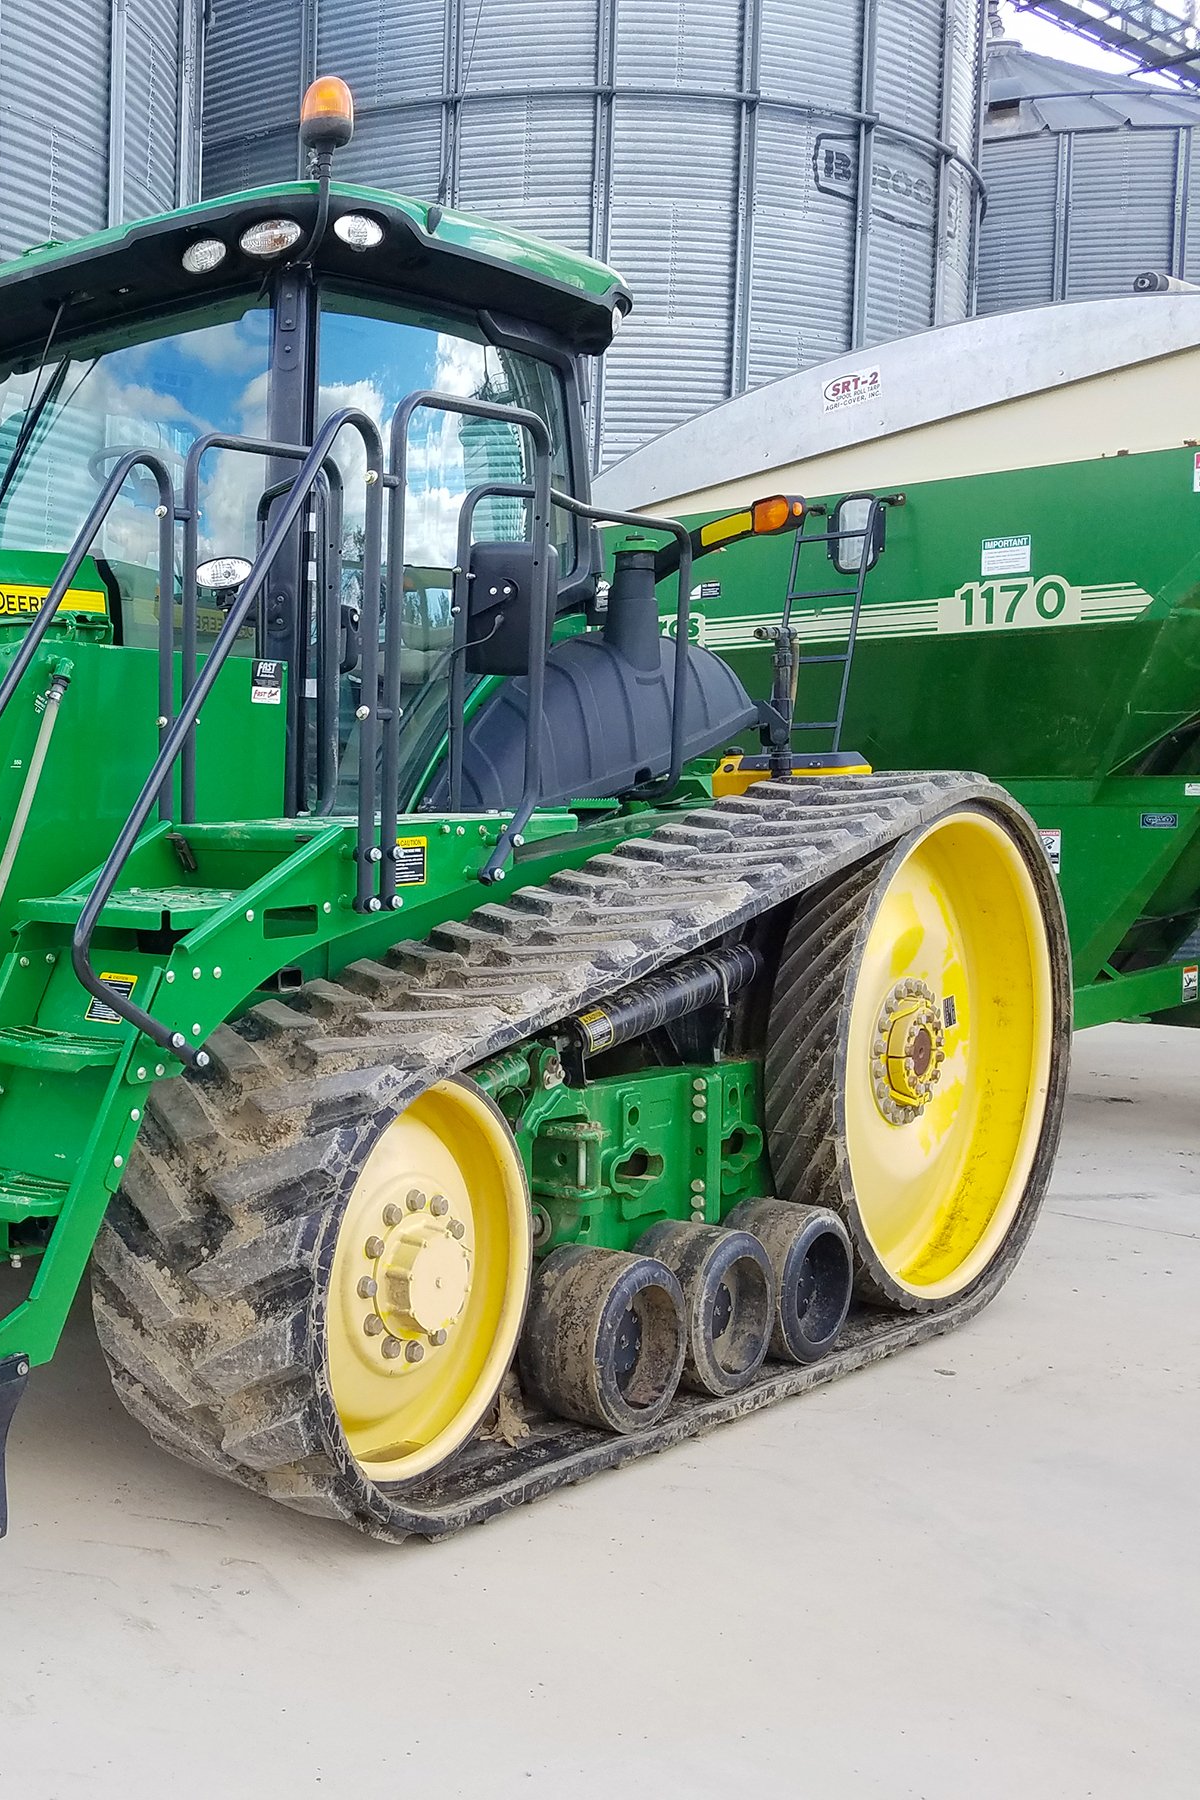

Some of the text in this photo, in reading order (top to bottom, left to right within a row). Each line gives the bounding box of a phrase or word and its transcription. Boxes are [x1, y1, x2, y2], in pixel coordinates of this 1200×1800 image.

[831, 371, 879, 397] SRT-2
[853, 388, 867, 396] ROLL
[867, 383, 881, 392] TARP
[984, 537, 1029, 549] IMPORTANT
[960, 581, 1066, 626] 1170
[257, 662, 277, 677] FAST
